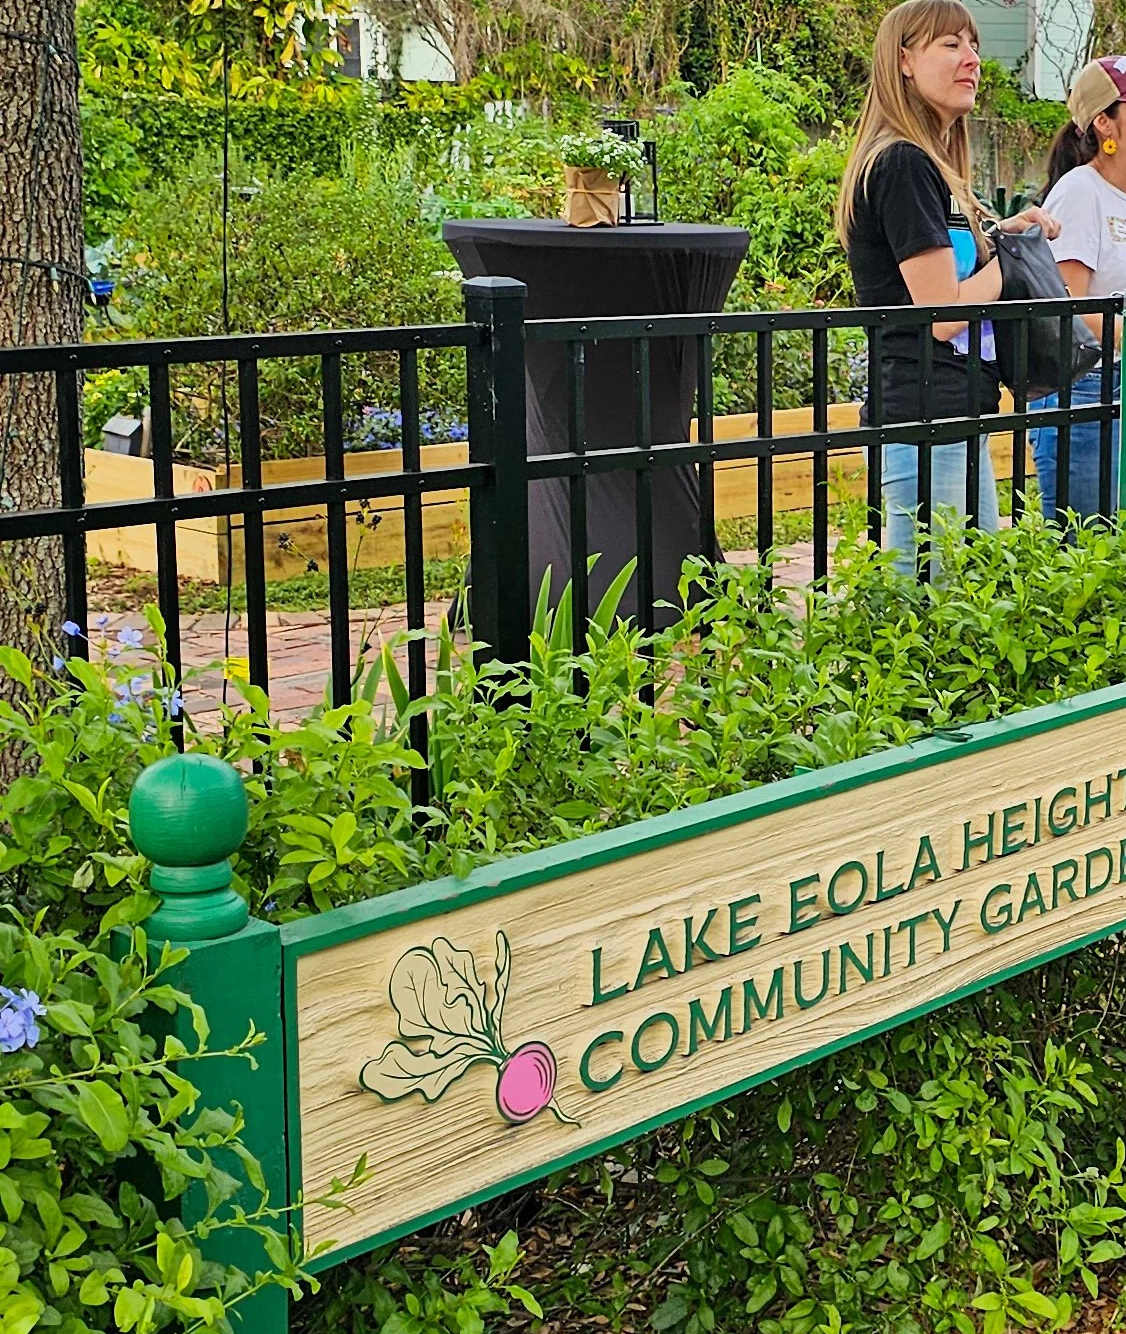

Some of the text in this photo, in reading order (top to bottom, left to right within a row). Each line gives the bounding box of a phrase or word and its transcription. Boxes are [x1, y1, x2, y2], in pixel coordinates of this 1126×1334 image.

[579, 899, 962, 1091] COMMUNITY
[591, 893, 761, 1006] LAKE
[789, 835, 941, 934] EOLA
